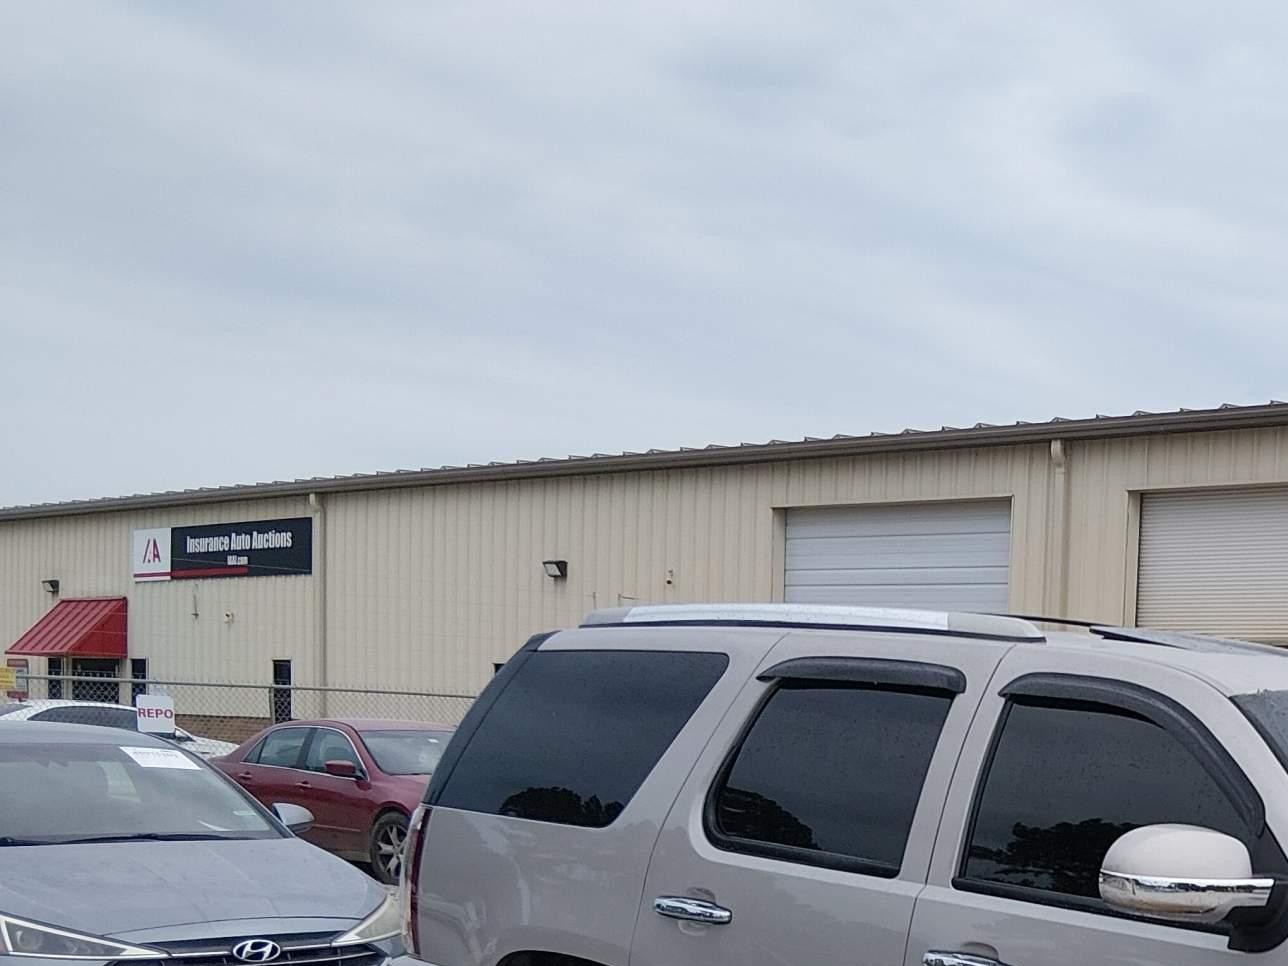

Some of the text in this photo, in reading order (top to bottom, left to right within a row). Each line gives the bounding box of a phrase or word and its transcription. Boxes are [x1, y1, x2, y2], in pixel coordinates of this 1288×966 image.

[186, 530, 293, 553] Insurance Auto Auctions
[138, 708, 174, 719] REPO
